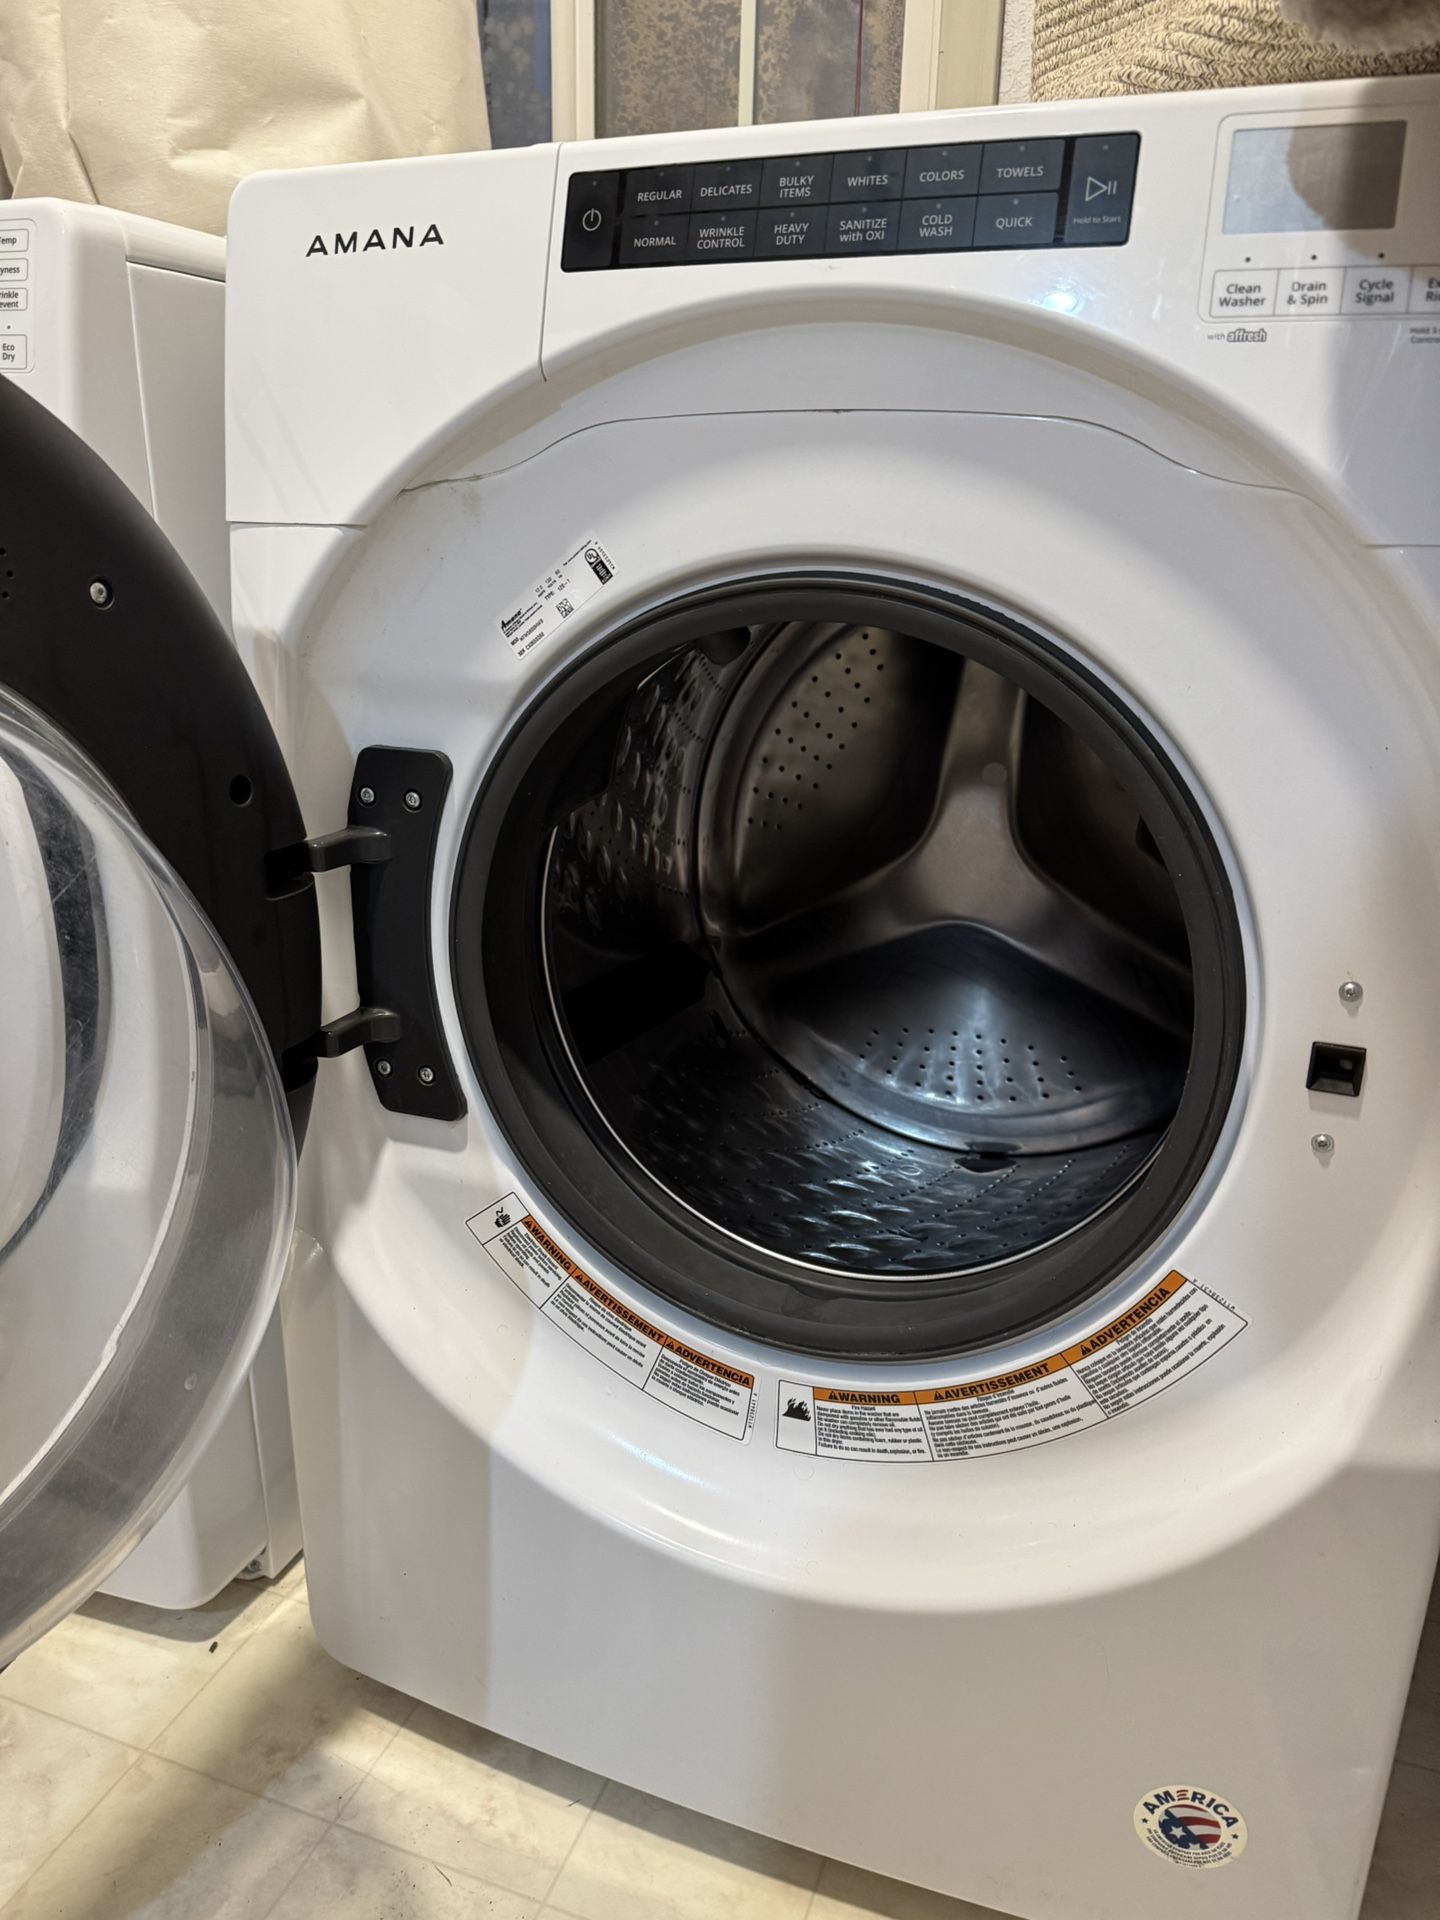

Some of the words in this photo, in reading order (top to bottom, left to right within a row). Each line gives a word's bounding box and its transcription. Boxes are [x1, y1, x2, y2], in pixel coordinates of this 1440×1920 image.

[919, 169, 965, 183] COLORS
[996, 166, 1044, 179] TOWELS
[779, 175, 815, 187] BULKY
[847, 174, 889, 187] WHITES
[637, 189, 683, 202] REGULAR
[700, 184, 752, 197] DELICATES
[779, 187, 811, 199] ITEMS
[839, 218, 888, 231] SANITIZE
[921, 214, 953, 225] COLD
[995, 216, 1033, 230] QUICK
[1073, 216, 1092, 225] Hold
[1093, 216, 1101, 224] to
[1102, 214, 1122, 224] Start
[699, 226, 745, 238] WRINKLE
[774, 222, 809, 235] HEAVY
[919, 226, 953, 238] WASH
[305, 224, 444, 257] AMANA
[633, 236, 677, 248] NORMAL
[775, 233, 805, 246] DUTY
[839, 231, 863, 242] with
[865, 230, 885, 241] OXI
[697, 237, 745, 250] CONTROL
[1226, 283, 1261, 295] Clean
[1292, 281, 1327, 293] Drain
[1359, 278, 1394, 292] Cycle
[1219, 295, 1266, 308] Washer
[1287, 295, 1297, 306] &
[1300, 294, 1329, 306] Spin
[1355, 291, 1395, 306] Signal
[1207, 332, 1225, 340] with
[1226, 328, 1267, 342] affresh
[2, 343, 15, 351] Eco
[2, 352, 15, 362] Dry
[530, 1226, 571, 1270] WARNING
[583, 1280, 664, 1342] AVERTISSEMENT
[1089, 1287, 1170, 1350] ADVERTENCIA
[673, 1345, 750, 1386] ADVERTENCIA
[945, 1363, 1050, 1400] AVERTISSEMENT
[838, 1393, 900, 1404] WARNING
[1142, 1789, 1239, 1828] AMERICA
